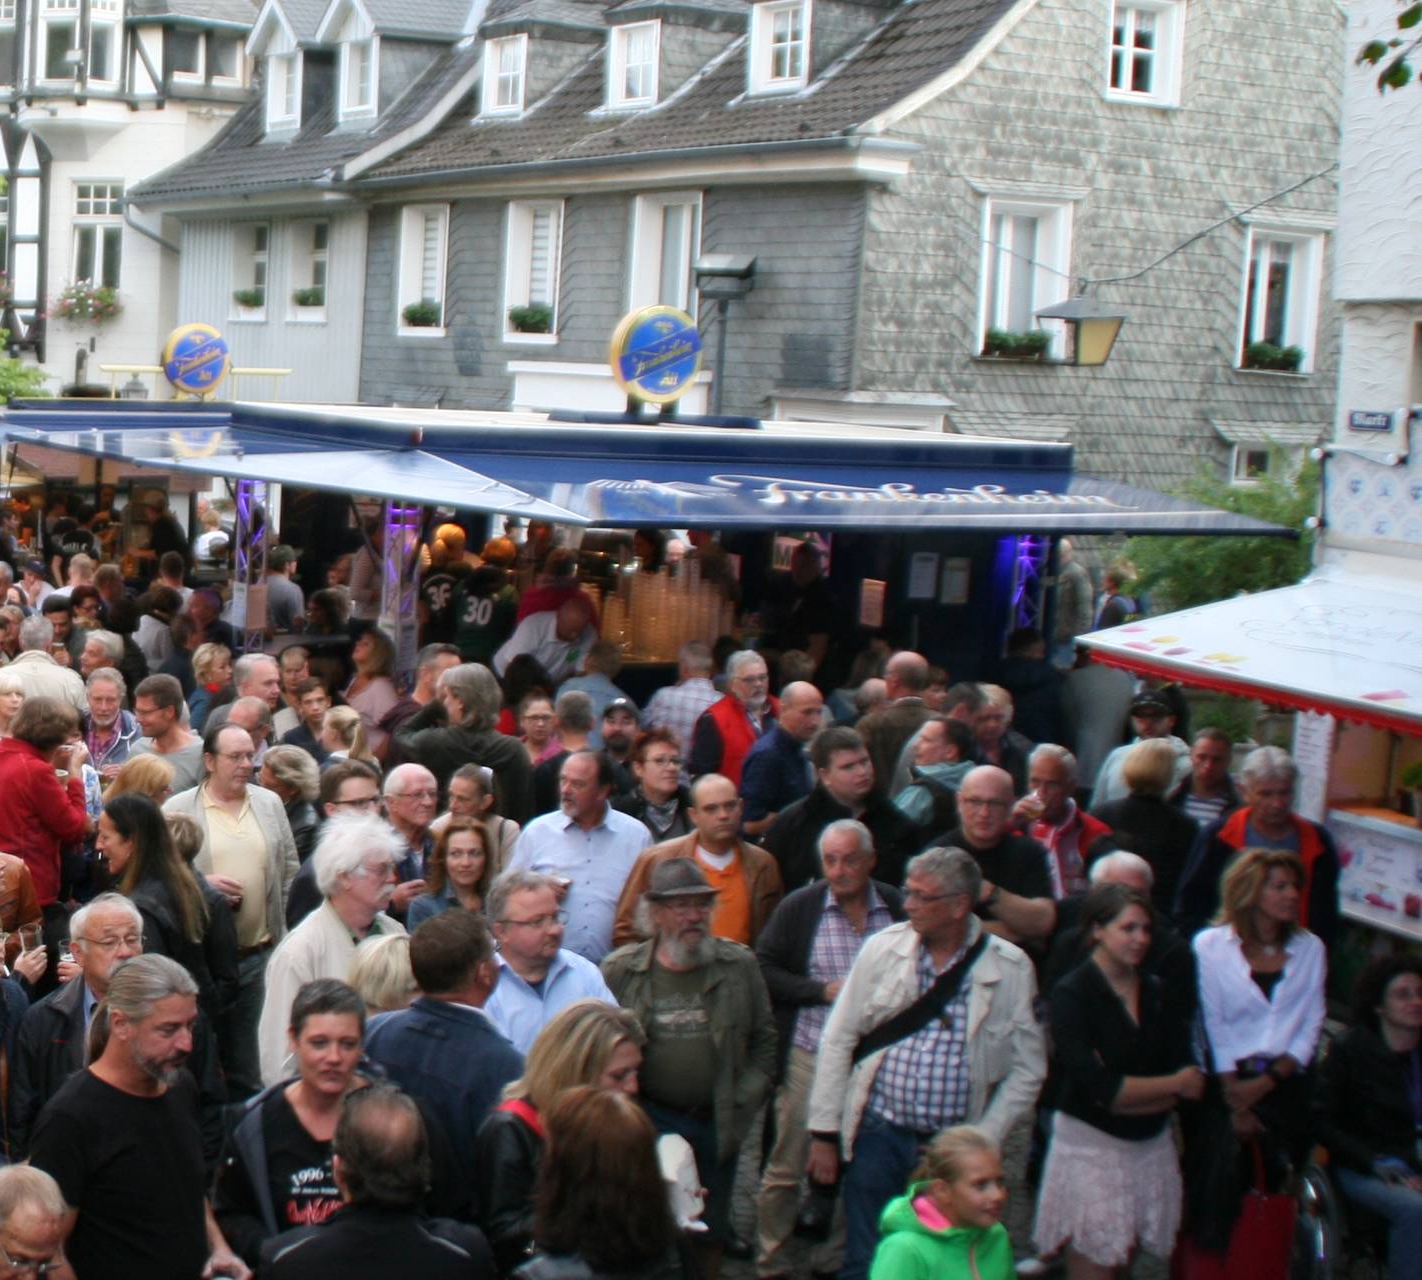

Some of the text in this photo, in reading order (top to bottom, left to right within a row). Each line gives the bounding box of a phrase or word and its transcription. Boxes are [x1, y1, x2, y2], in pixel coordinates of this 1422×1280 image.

[710, 473, 1139, 508] Frankenheim
[463, 595, 493, 626] 30
[291, 1168, 324, 1187] 1996
